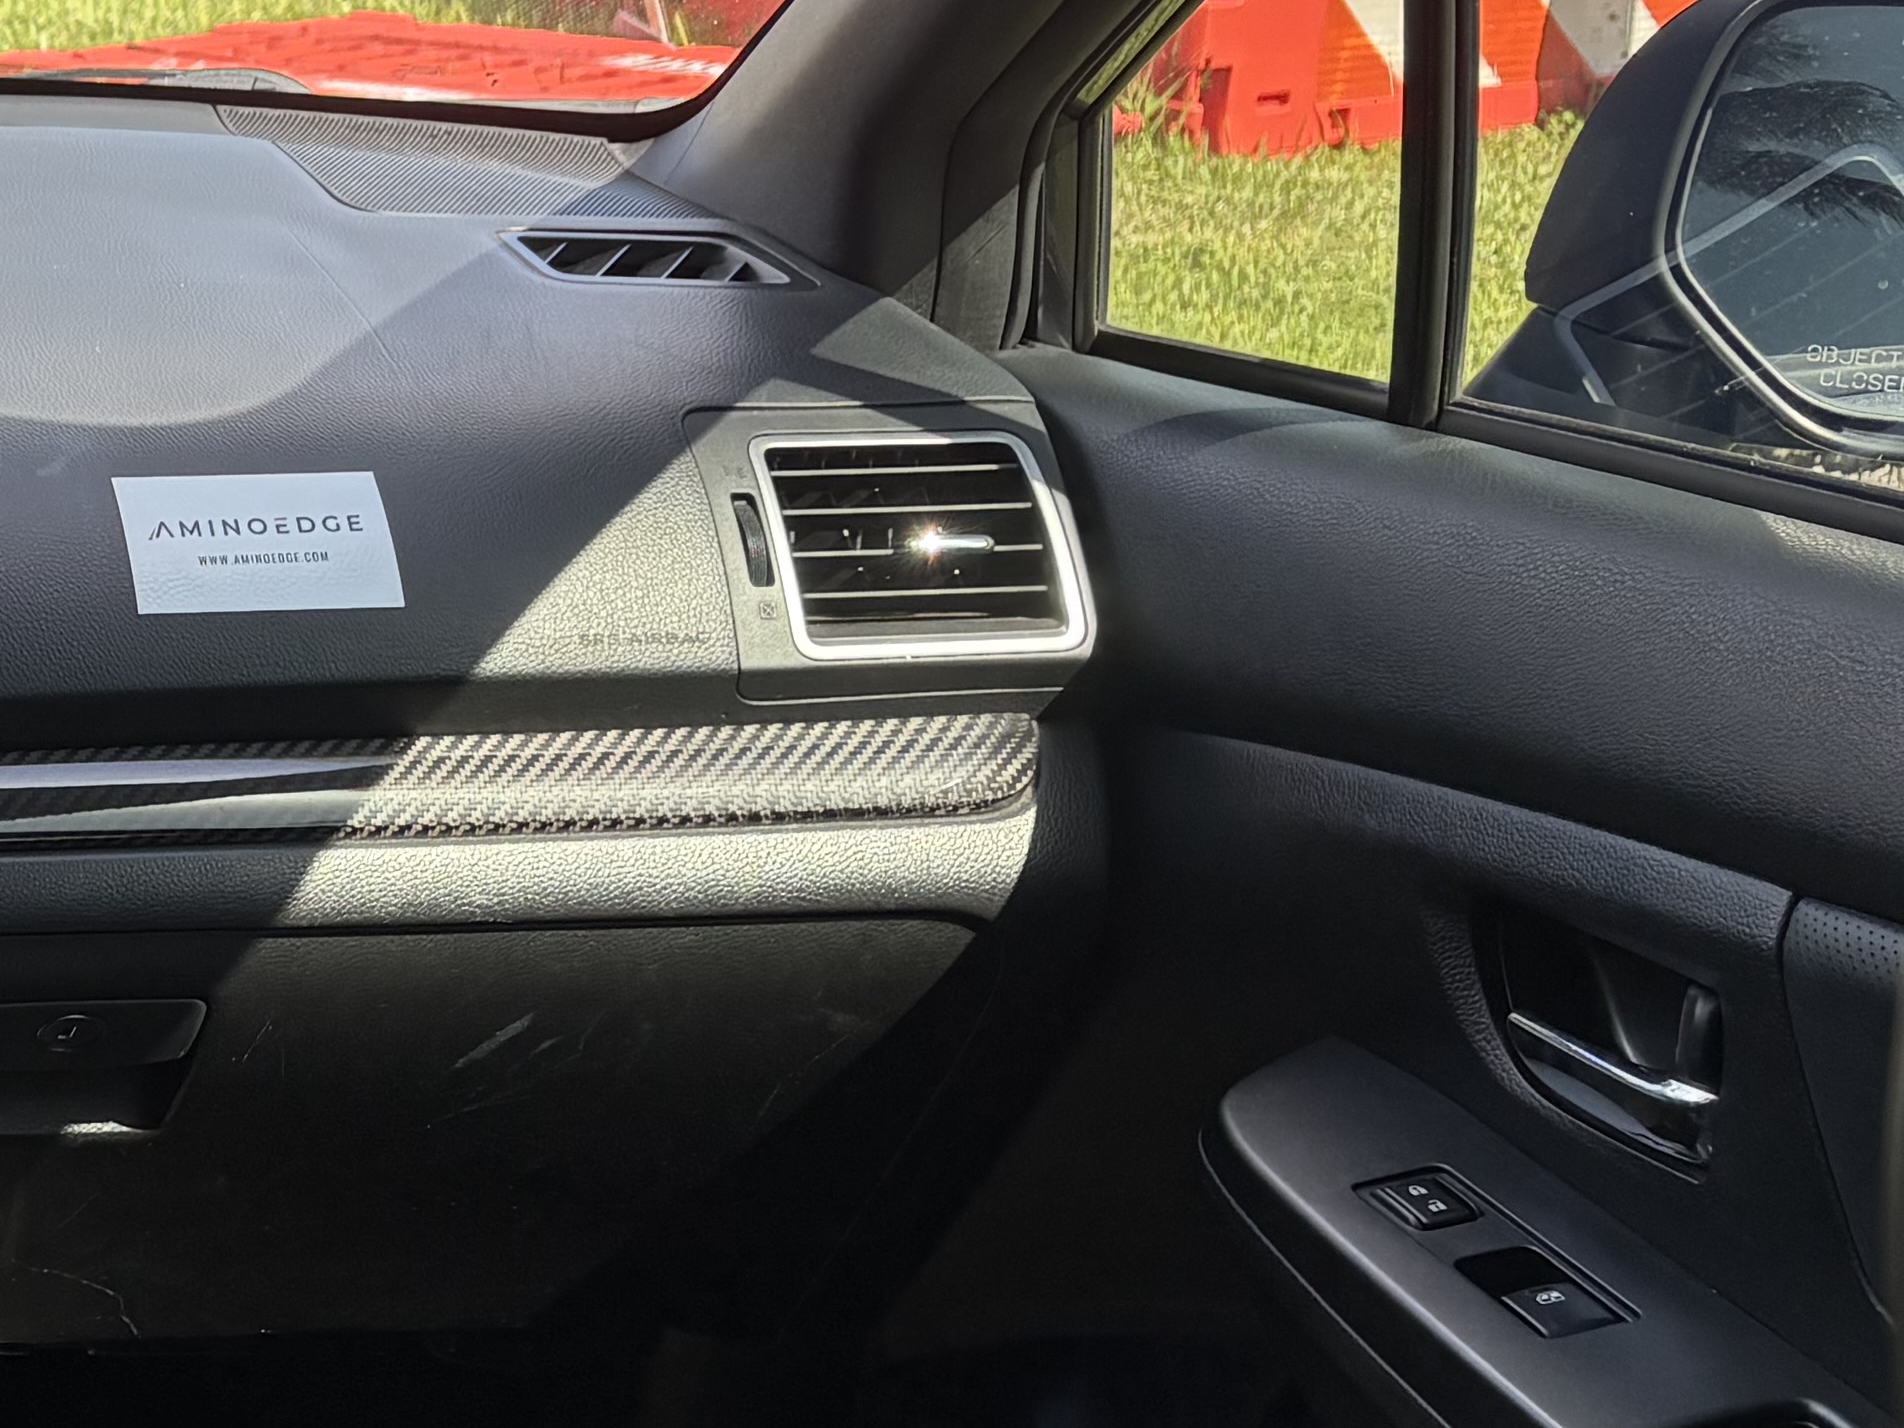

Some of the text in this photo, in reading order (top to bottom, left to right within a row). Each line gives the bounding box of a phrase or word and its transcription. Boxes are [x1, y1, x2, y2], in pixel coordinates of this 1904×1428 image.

[1819, 368, 1904, 393] CLOSE
[148, 514, 364, 540] AMINOEDGE
[197, 551, 330, 566] WWW.AMINOEDGE.COM
